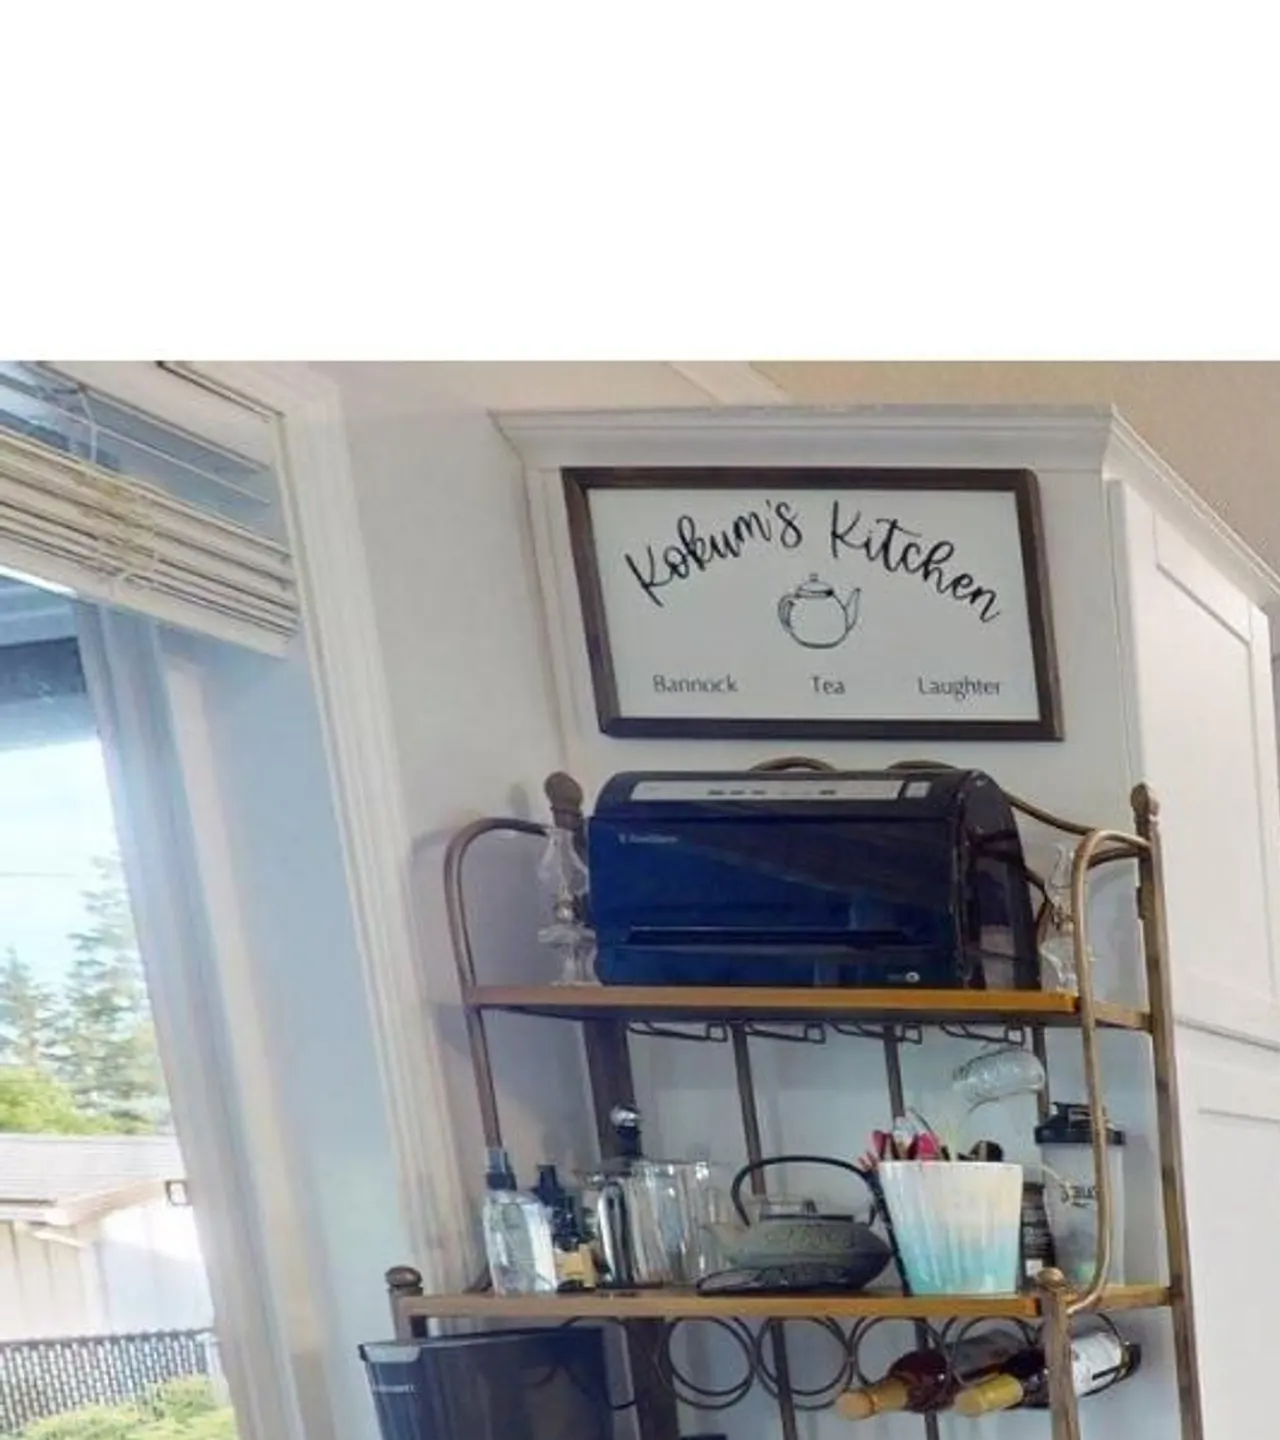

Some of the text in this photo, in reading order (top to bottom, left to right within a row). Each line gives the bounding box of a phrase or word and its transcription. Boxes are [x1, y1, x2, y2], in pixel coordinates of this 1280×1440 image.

[625, 499, 1000, 623] Kokum's Kitchen
[653, 673, 1001, 701] Bannock Tea Laughter
